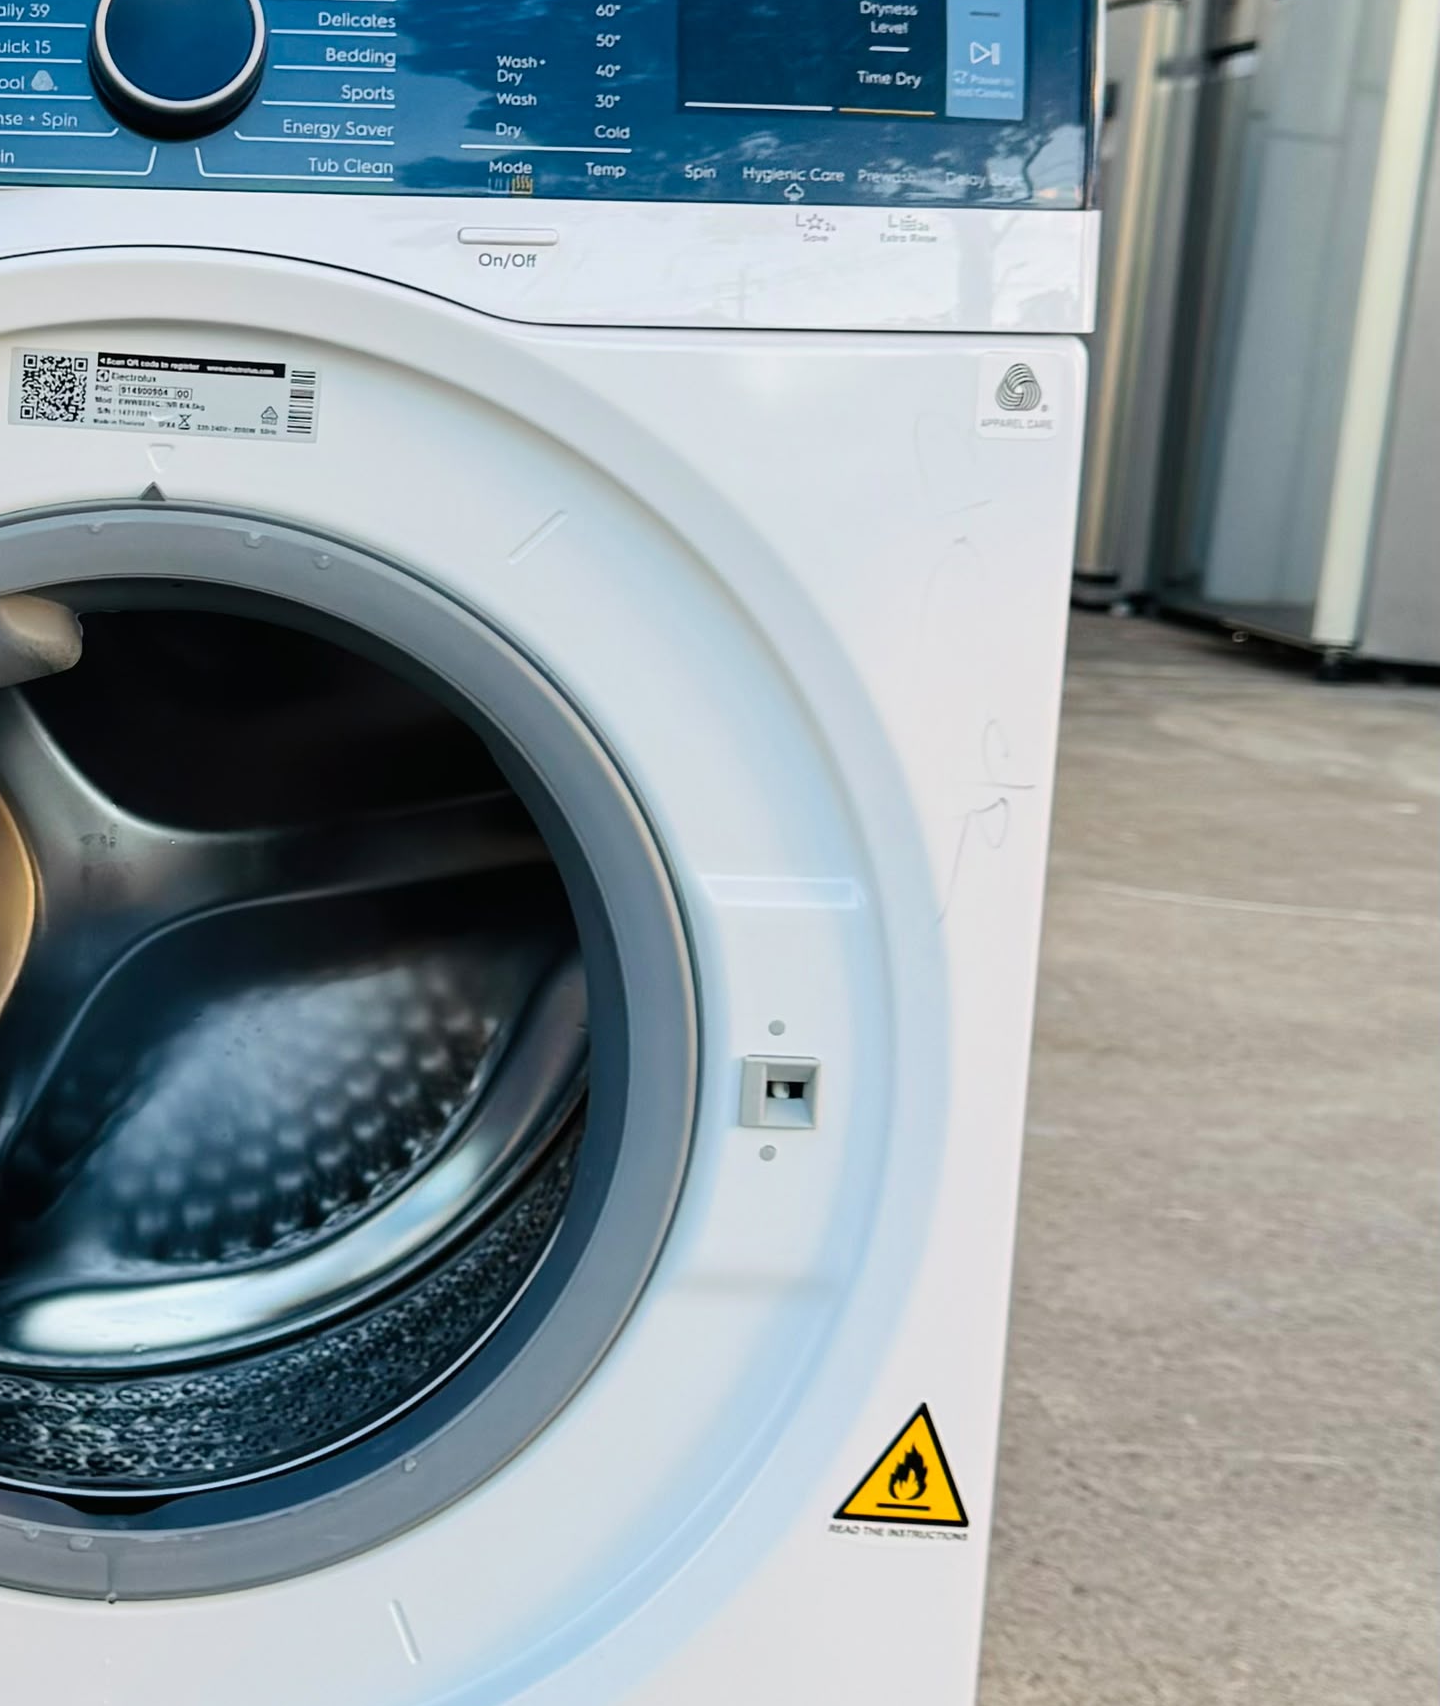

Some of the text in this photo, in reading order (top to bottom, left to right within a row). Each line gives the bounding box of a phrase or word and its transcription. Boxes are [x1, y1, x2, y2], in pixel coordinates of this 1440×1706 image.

[29, 4, 50, 18] 39
[595, 4, 621, 17] 60°
[860, 0, 918, 18] Dryness
[318, 12, 396, 28] Delicates
[871, 21, 909, 34] Level
[35, 40, 51, 54] 15
[595, 34, 621, 48] 50°
[326, 47, 396, 67] Bedding
[497, 69, 522, 86] Dry
[595, 64, 621, 78] 40°
[857, 70, 922, 89] Time Dry
[341, 84, 395, 102] Sports
[496, 93, 537, 106] Wash
[595, 94, 621, 108] 30°
[42, 112, 77, 129] Spin
[283, 119, 394, 139] Energy Saver
[495, 122, 522, 139] Dry
[594, 125, 630, 139] Cold
[308, 157, 393, 173] Tub Clean
[489, 161, 532, 174] Mode
[585, 162, 626, 179] Temp
[684, 165, 717, 181] Spin
[742, 167, 845, 184] Hygienic Care
[478, 252, 537, 269] On/Off
[106, 357, 126, 365] Scan
[127, 359, 139, 367] QR
[161, 361, 169, 369] to
[111, 372, 157, 383] Electrolux
[828, 1524, 861, 1536] READ
[864, 1526, 885, 1537] THE
